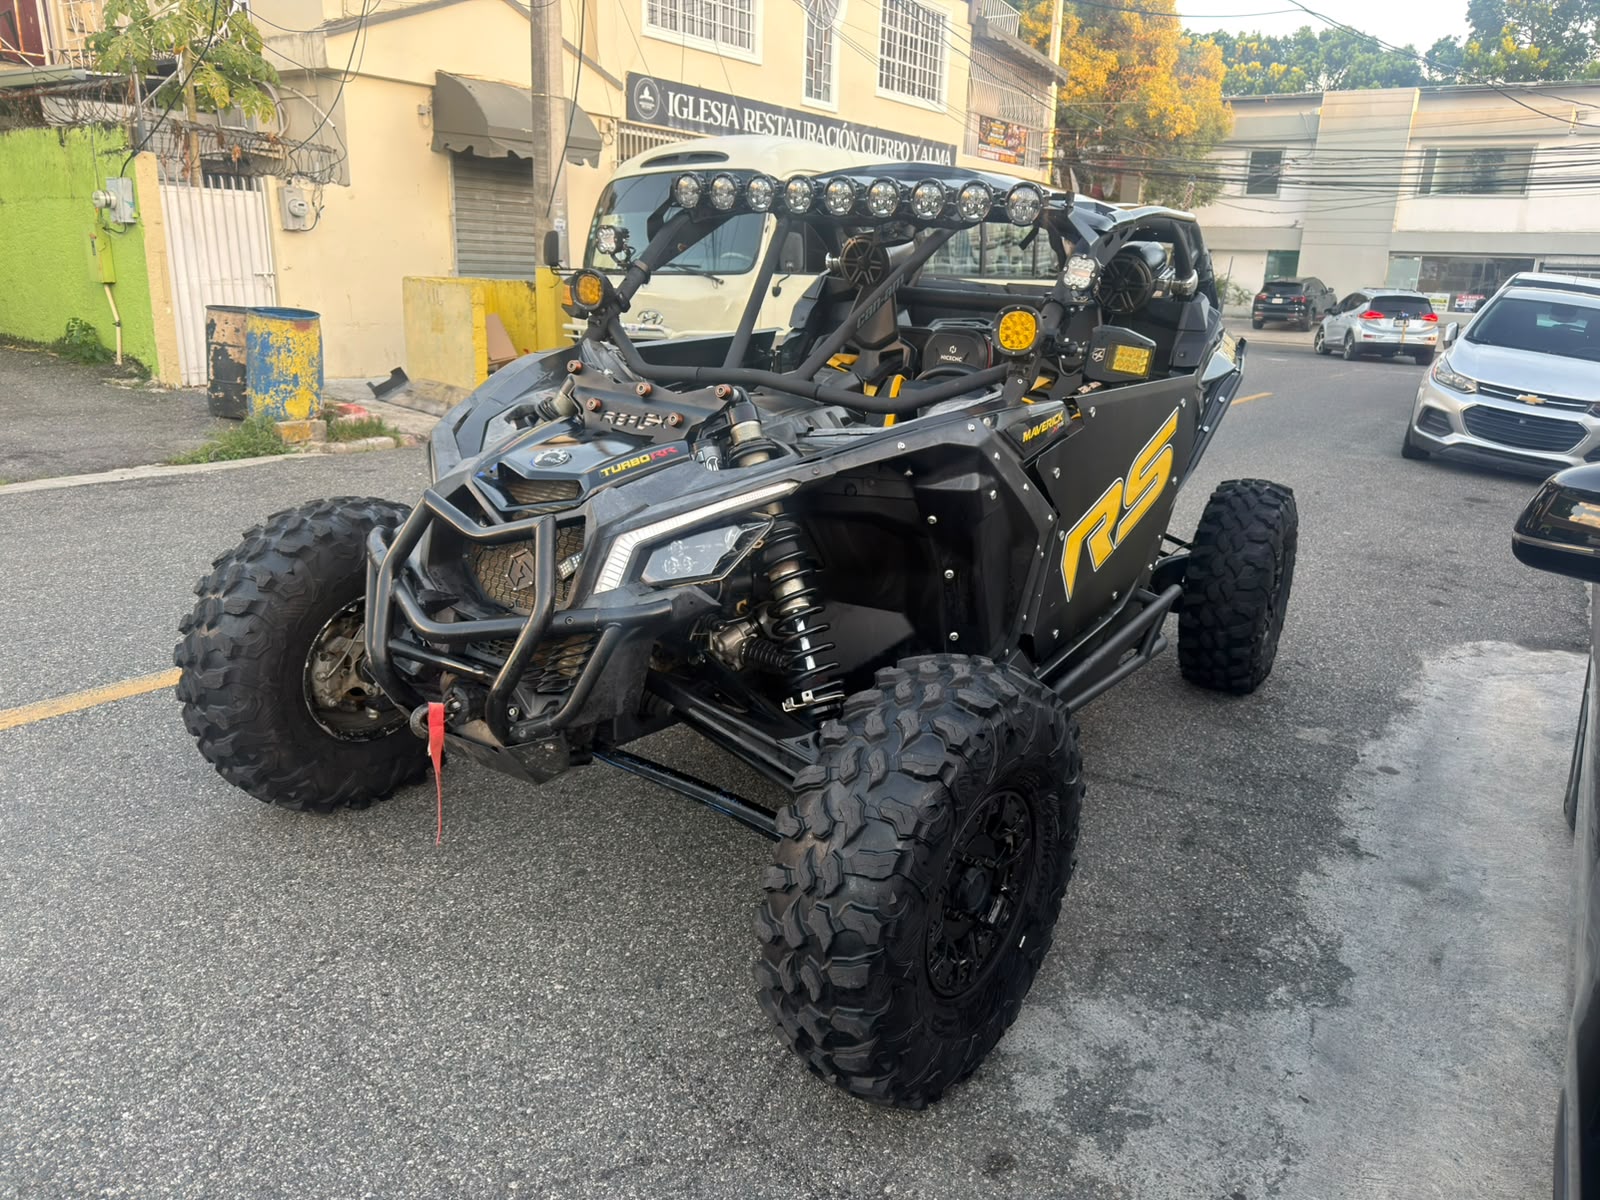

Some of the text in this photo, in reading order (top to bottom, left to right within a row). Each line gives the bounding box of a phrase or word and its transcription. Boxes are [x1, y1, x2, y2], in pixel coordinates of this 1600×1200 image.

[667, 91, 740, 130] IGLESIA
[743, 107, 860, 153] RESTAURACIÓN
[861, 133, 910, 161] CUERPO
[911, 143, 920, 163] Y
[919, 145, 952, 166] ALMA
[856, 273, 905, 329] can-am
[1022, 410, 1064, 443] MAVERICK
[1060, 405, 1180, 603] RS
